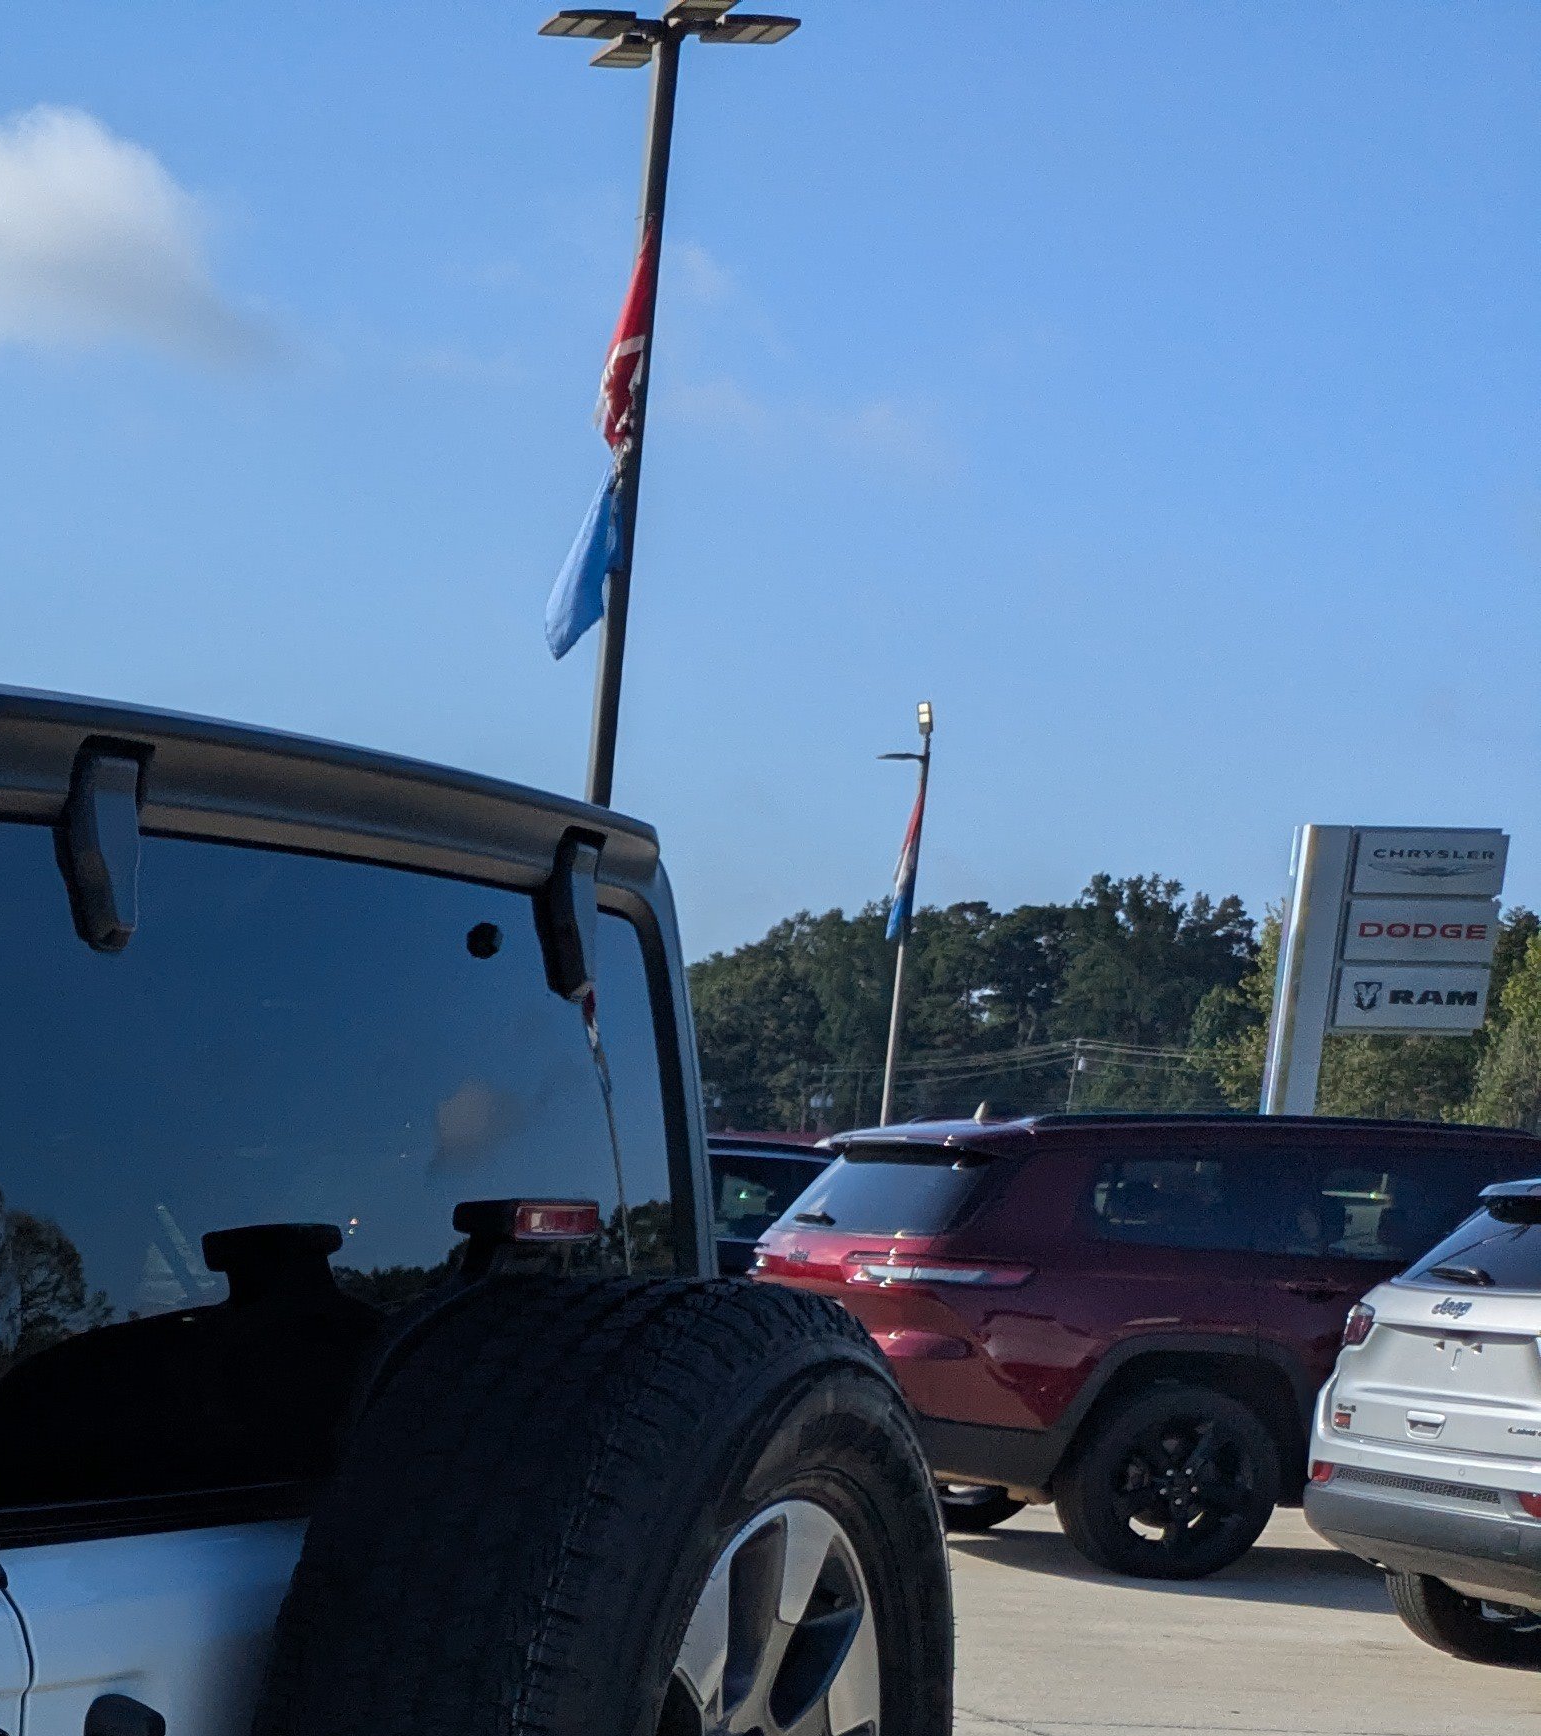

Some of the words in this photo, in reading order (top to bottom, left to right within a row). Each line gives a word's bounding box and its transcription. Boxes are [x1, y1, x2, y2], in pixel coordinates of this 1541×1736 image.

[1373, 848, 1495, 860] CHRYSLER
[1358, 922, 1488, 940] DODGE
[1388, 989, 1478, 1006] RAM
